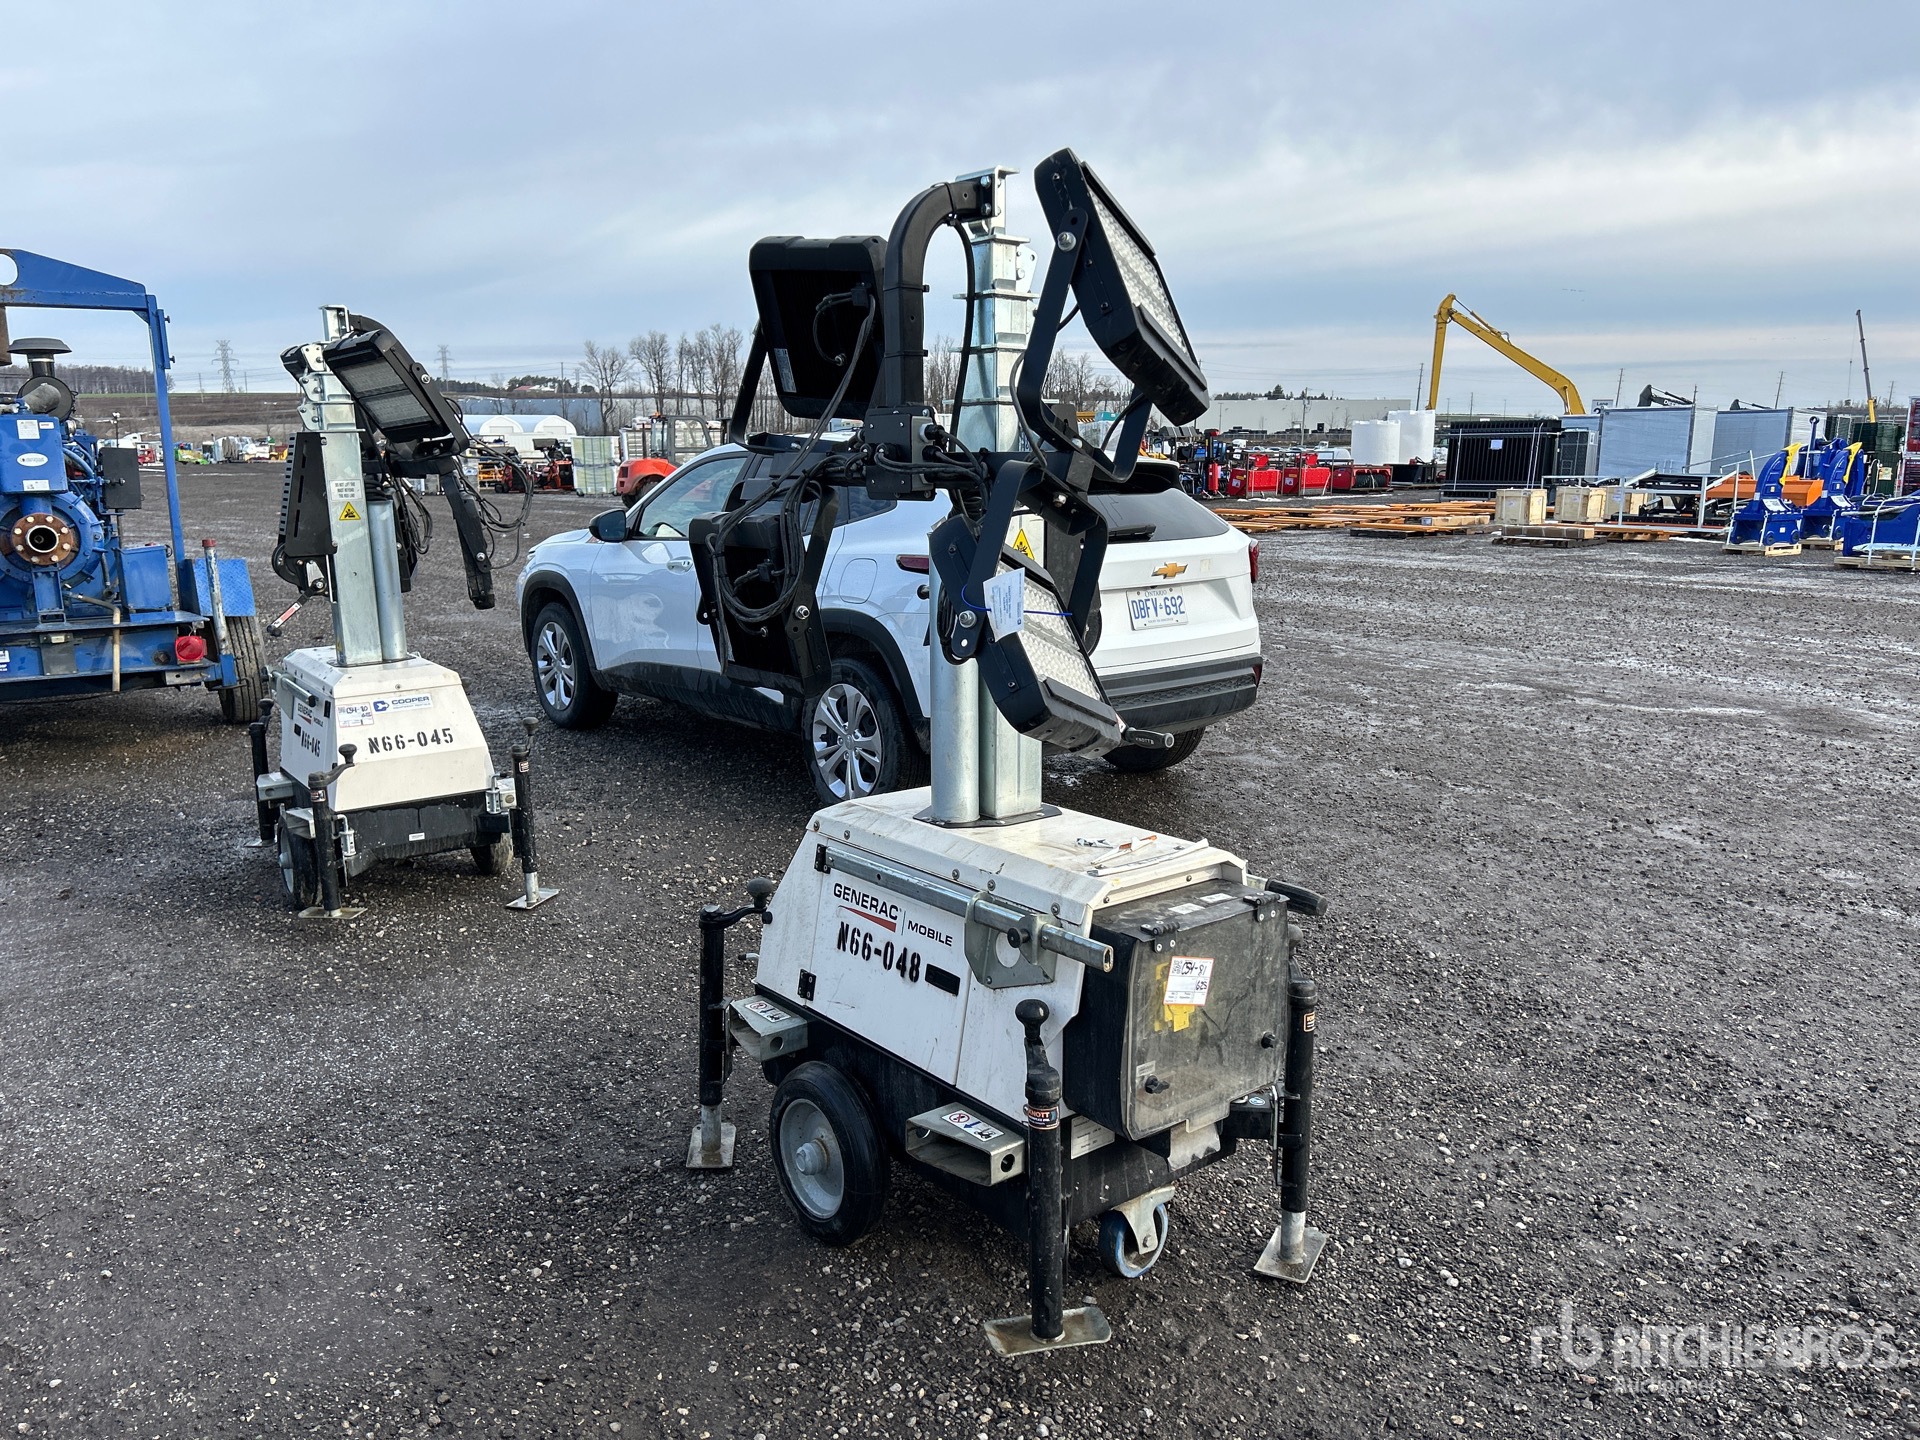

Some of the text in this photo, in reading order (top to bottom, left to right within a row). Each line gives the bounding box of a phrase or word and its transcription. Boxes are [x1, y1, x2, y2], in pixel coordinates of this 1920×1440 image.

[391, 696, 430, 705] COOPER
[301, 730, 321, 758] N66-045
[367, 727, 454, 754] N66-045
[833, 882, 900, 921] GENERAC
[907, 919, 953, 947] MOBILE
[837, 920, 922, 983] N66-048
[1028, 1109, 1050, 1118] KNOTT
